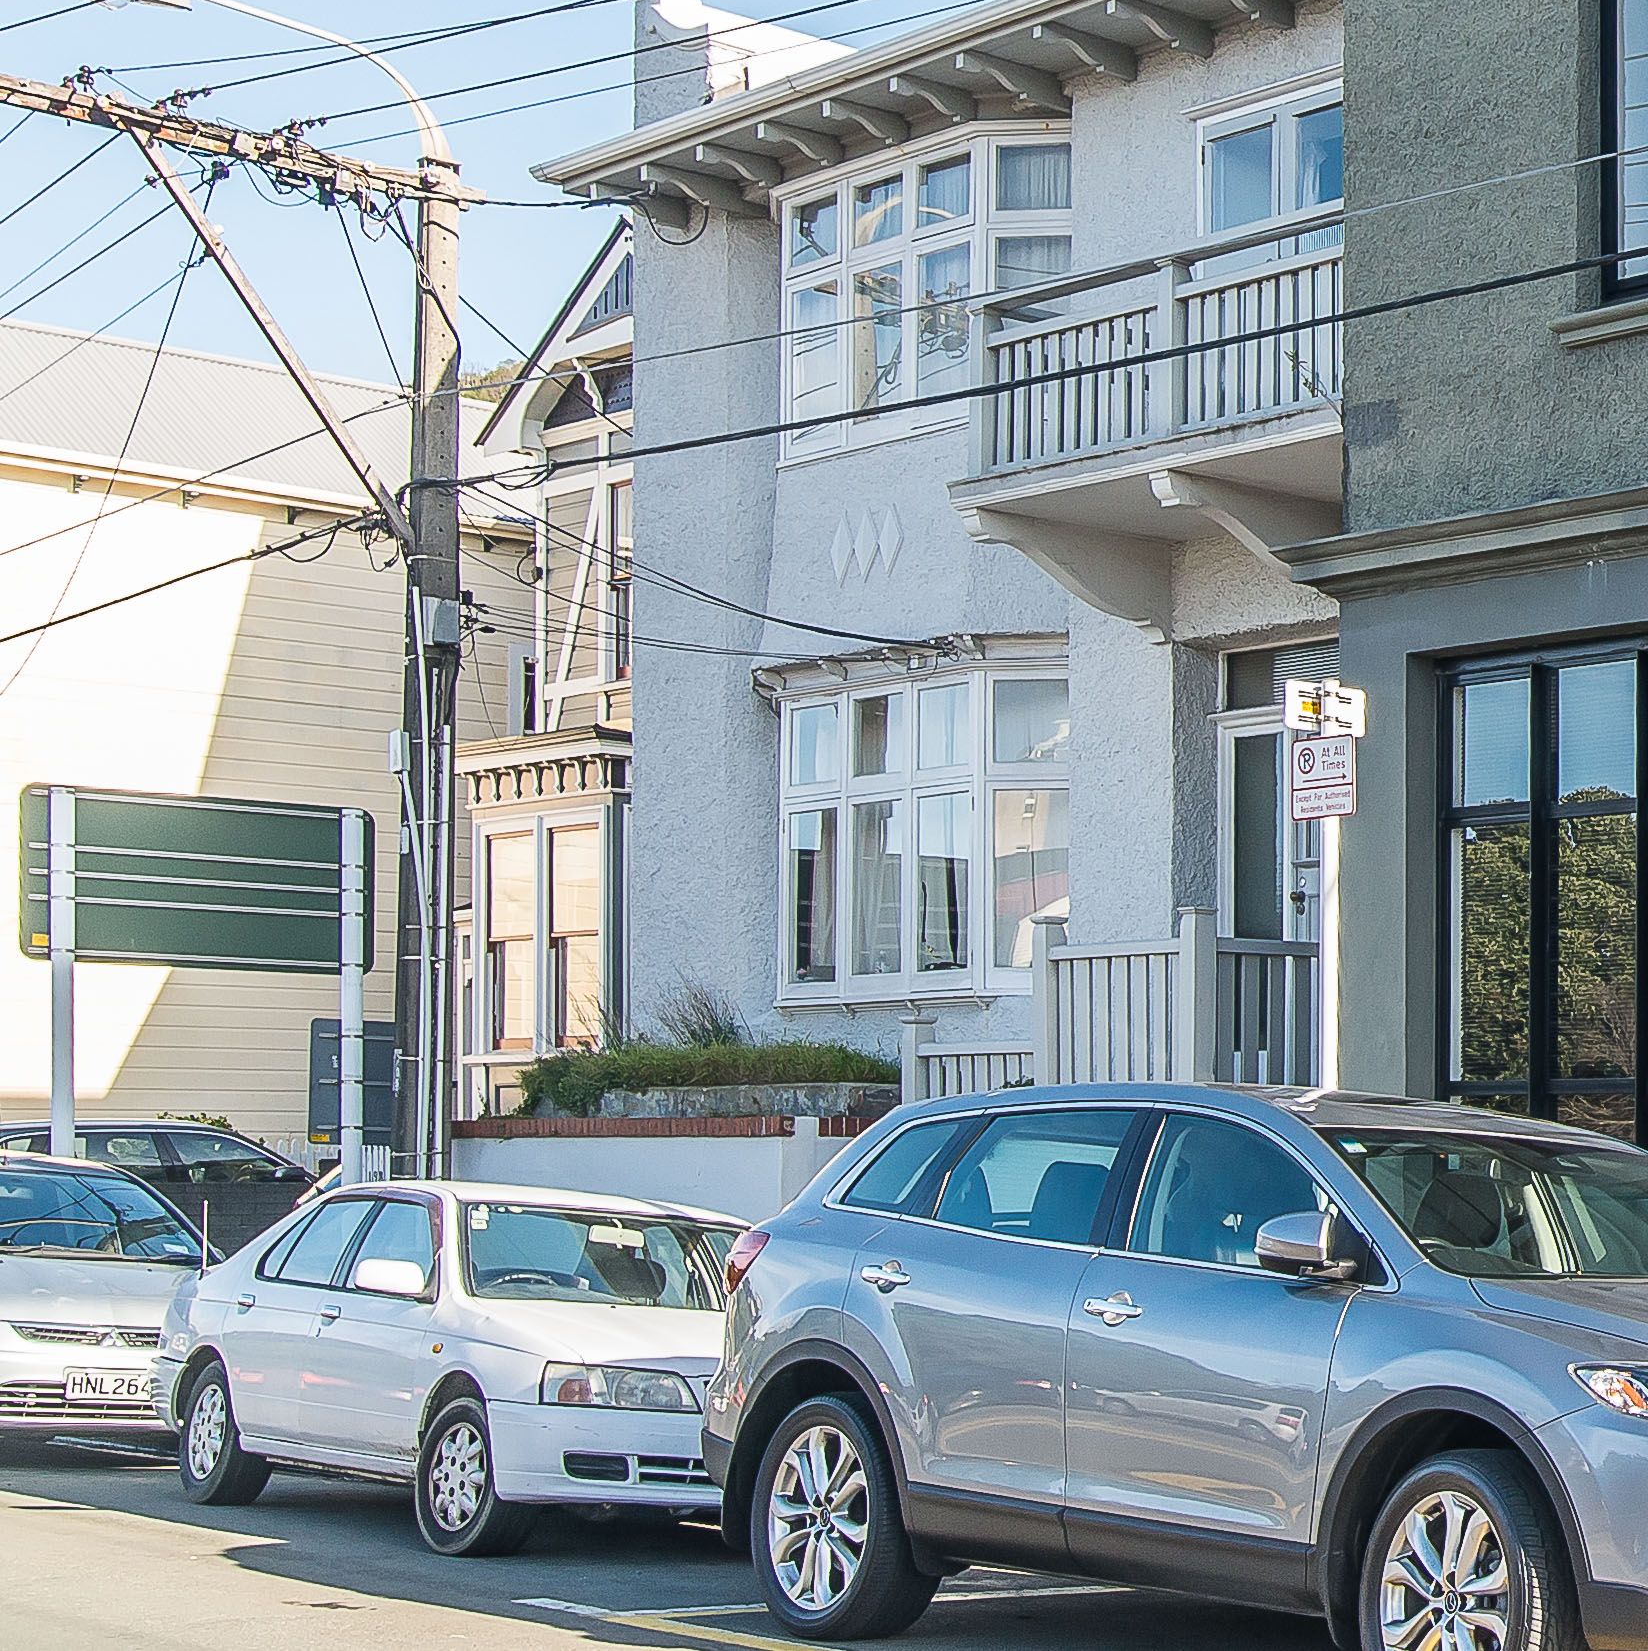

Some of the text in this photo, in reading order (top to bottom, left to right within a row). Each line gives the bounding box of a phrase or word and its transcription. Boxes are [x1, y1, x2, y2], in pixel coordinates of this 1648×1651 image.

[1321, 744, 1346, 758] At All
[1321, 760, 1346, 771] Times
[71, 1376, 150, 1396] HNL264
